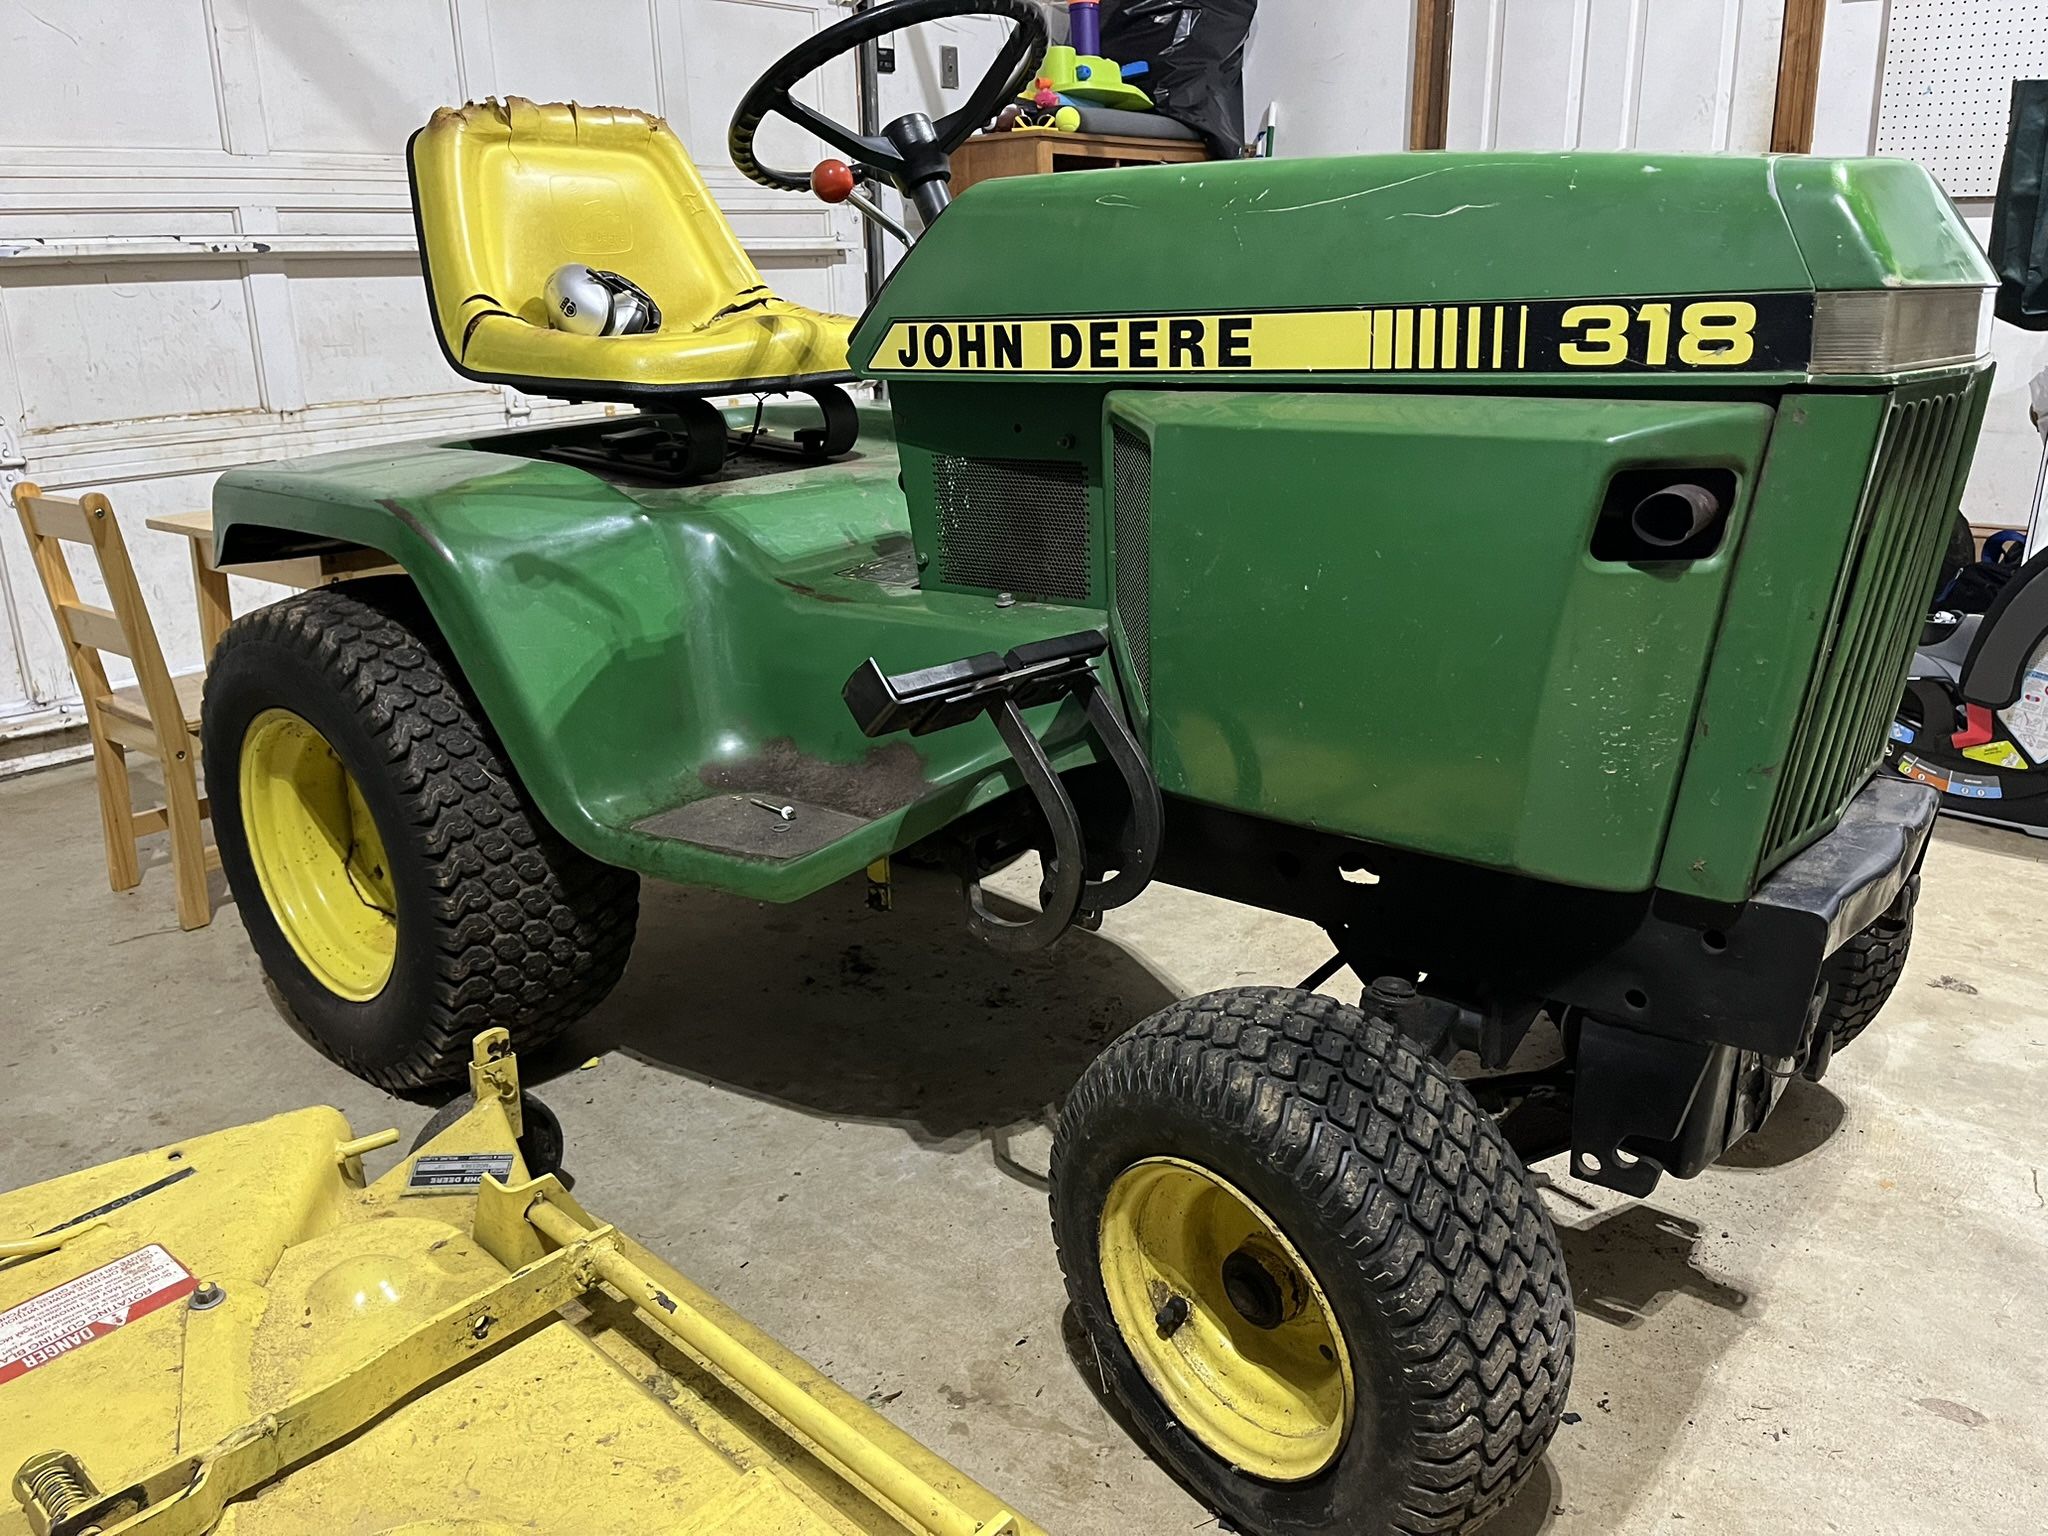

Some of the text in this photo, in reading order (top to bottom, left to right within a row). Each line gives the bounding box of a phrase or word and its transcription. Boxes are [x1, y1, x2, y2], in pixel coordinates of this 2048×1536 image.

[898, 317, 1253, 369] JOHN DEERE
[1558, 301, 1757, 366] 318
[0, 1306, 38, 1327] WITHOU
[0, 1287, 152, 1364] ROTATING CUTTING BLA
[14, 1321, 43, 1337] FROM
[43, 1301, 85, 1323] THROWN
[19, 1326, 96, 1368] DANGER
